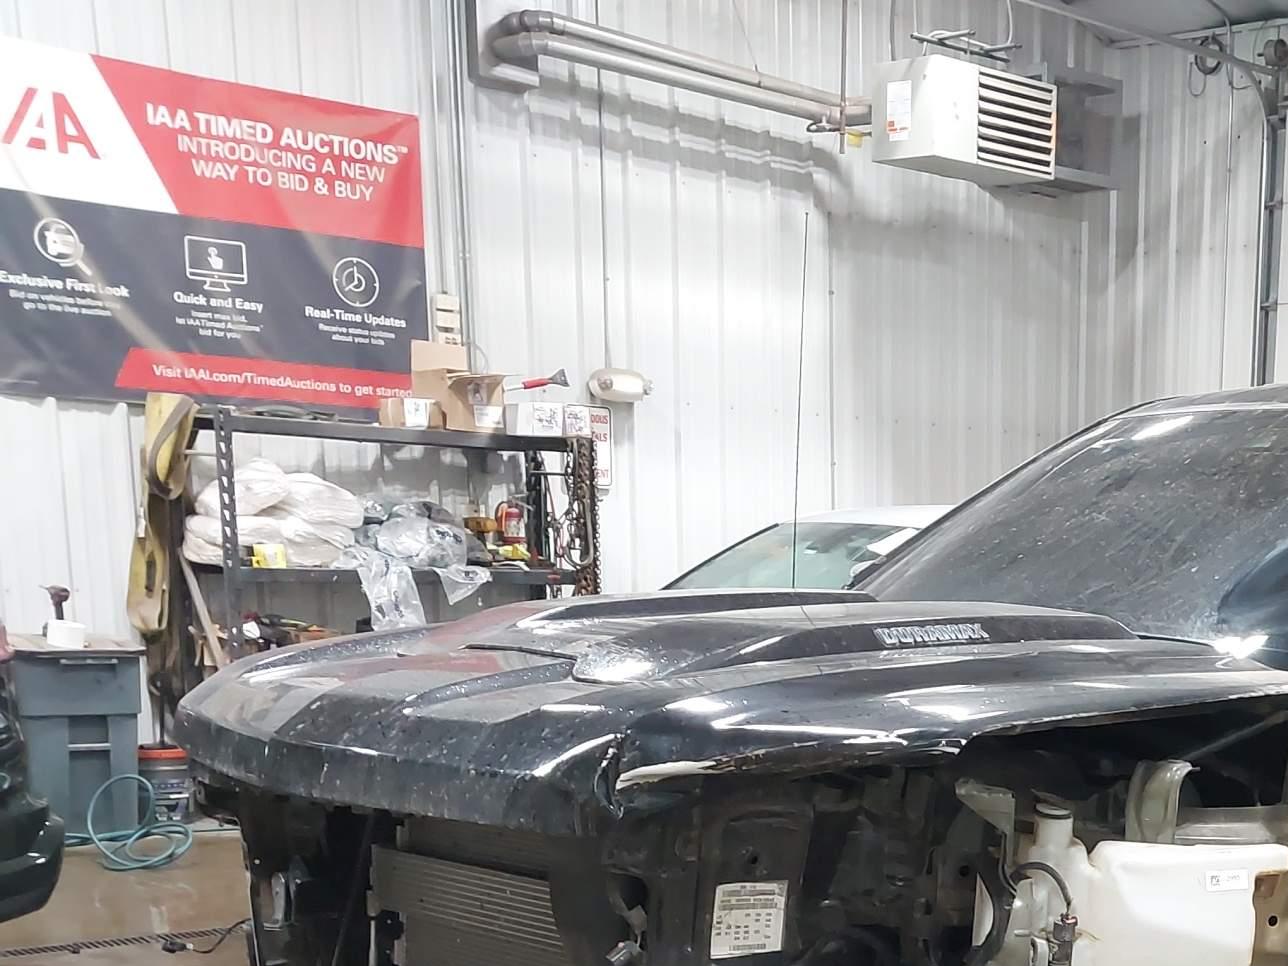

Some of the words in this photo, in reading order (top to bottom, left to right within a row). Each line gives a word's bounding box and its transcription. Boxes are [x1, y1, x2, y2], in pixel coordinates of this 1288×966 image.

[146, 102, 192, 132] IAA
[194, 111, 274, 145] TIMED
[177, 134, 317, 173] INTRODUCING
[322, 157, 337, 176] A
[341, 161, 385, 183] NEW
[191, 157, 240, 182] WAY
[243, 165, 273, 187] TO
[277, 171, 309, 192] BID
[314, 176, 329, 195] &
[334, 180, 374, 202] BUY
[0, 270, 64, 289] Exclusive
[173, 291, 207, 307] Quick
[209, 297, 233, 309] and
[234, 297, 263, 314] Easy
[304, 305, 363, 323] Real-Time
[364, 312, 407, 329] Updates
[152, 364, 182, 379] Visit
[338, 382, 352, 394] to
[354, 384, 374, 397] get
